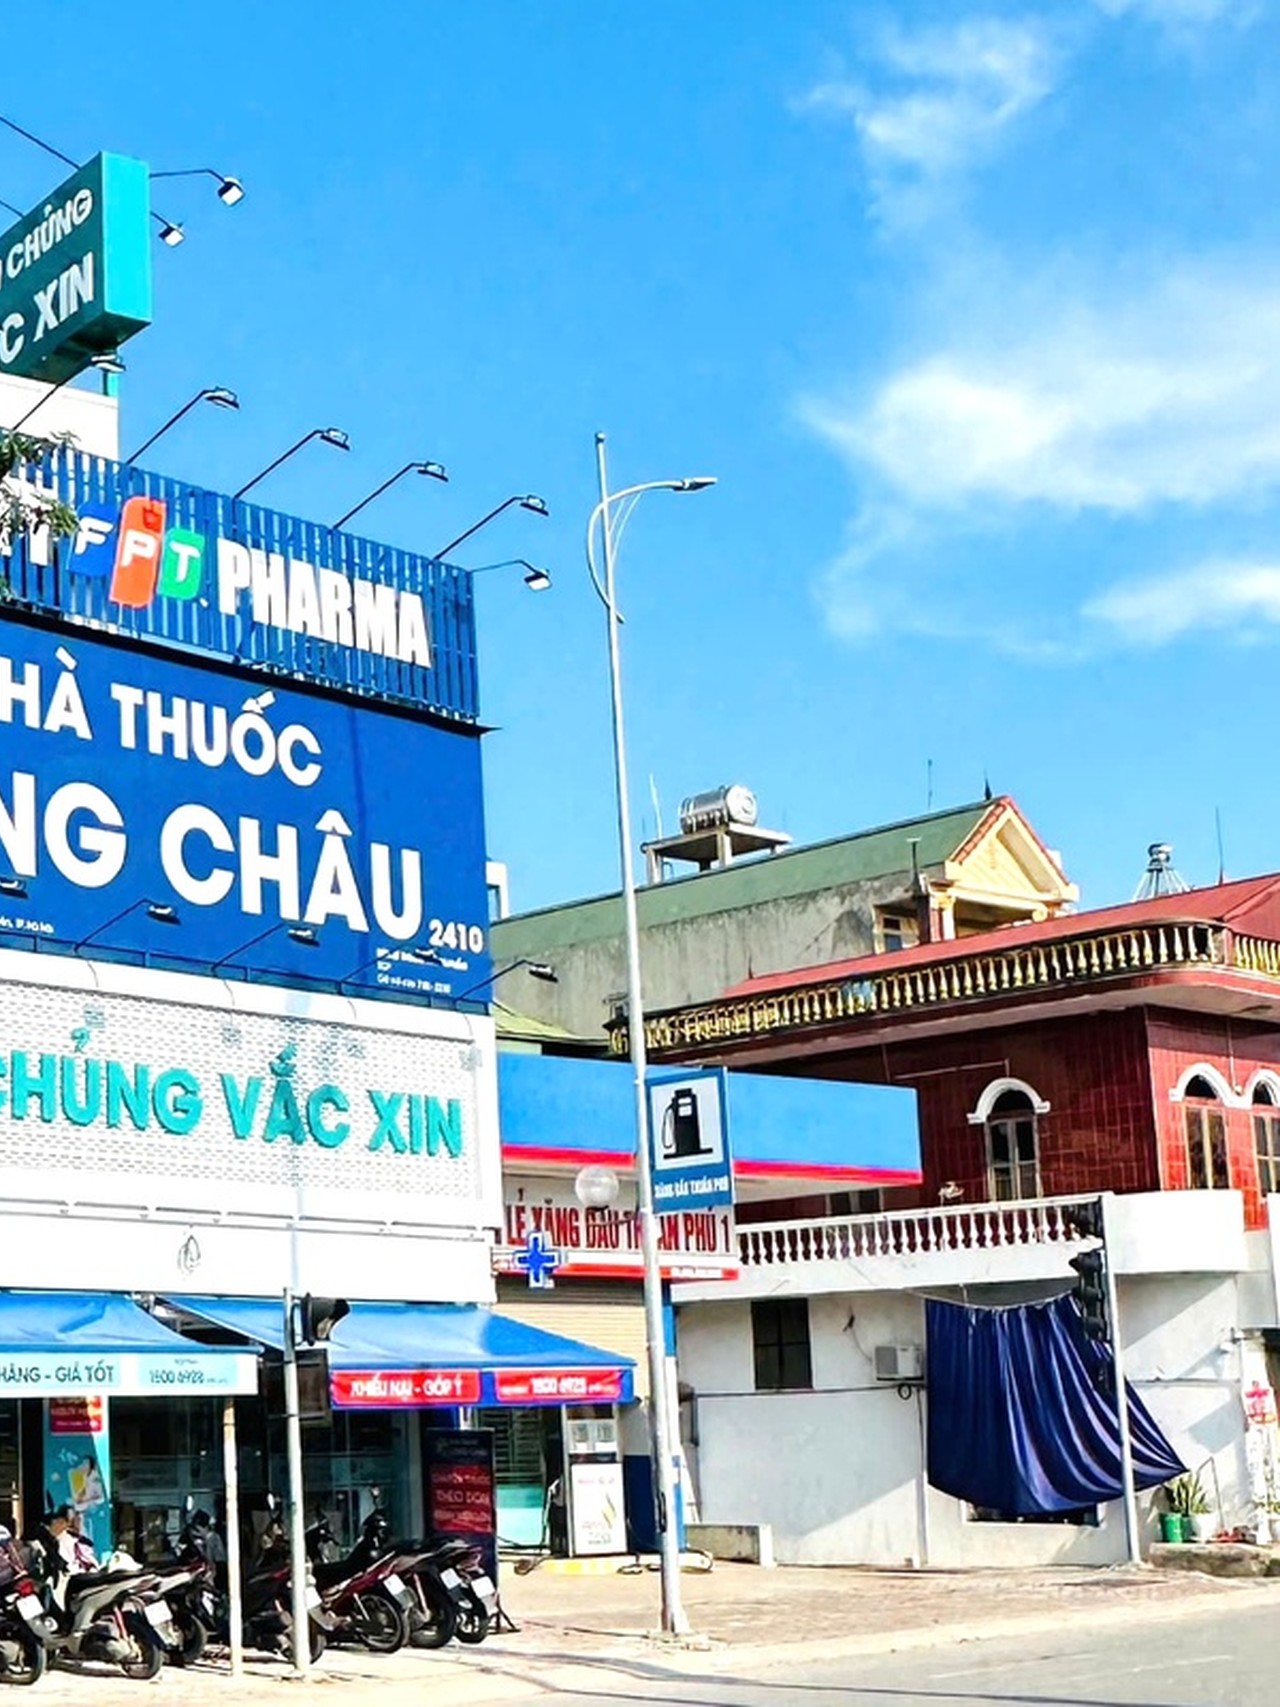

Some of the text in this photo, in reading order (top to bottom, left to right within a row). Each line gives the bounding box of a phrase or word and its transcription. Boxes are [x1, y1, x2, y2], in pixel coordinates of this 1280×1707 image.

[6, 188, 94, 279] CHỦNG
[32, 251, 94, 343] XIN
[71, 510, 204, 596] FPT
[218, 537, 432, 669] PHARMA
[110, 689, 323, 788] THUỐC
[160, 803, 422, 940] CHÂU
[428, 918, 484, 954] 2410
[220, 1041, 352, 1150] VẮC
[367, 1088, 463, 1158] XIN
[684, 1206, 718, 1252] PHÚ
[721, 1214, 731, 1253] 1
[85, 1358, 114, 1383] TỐT
